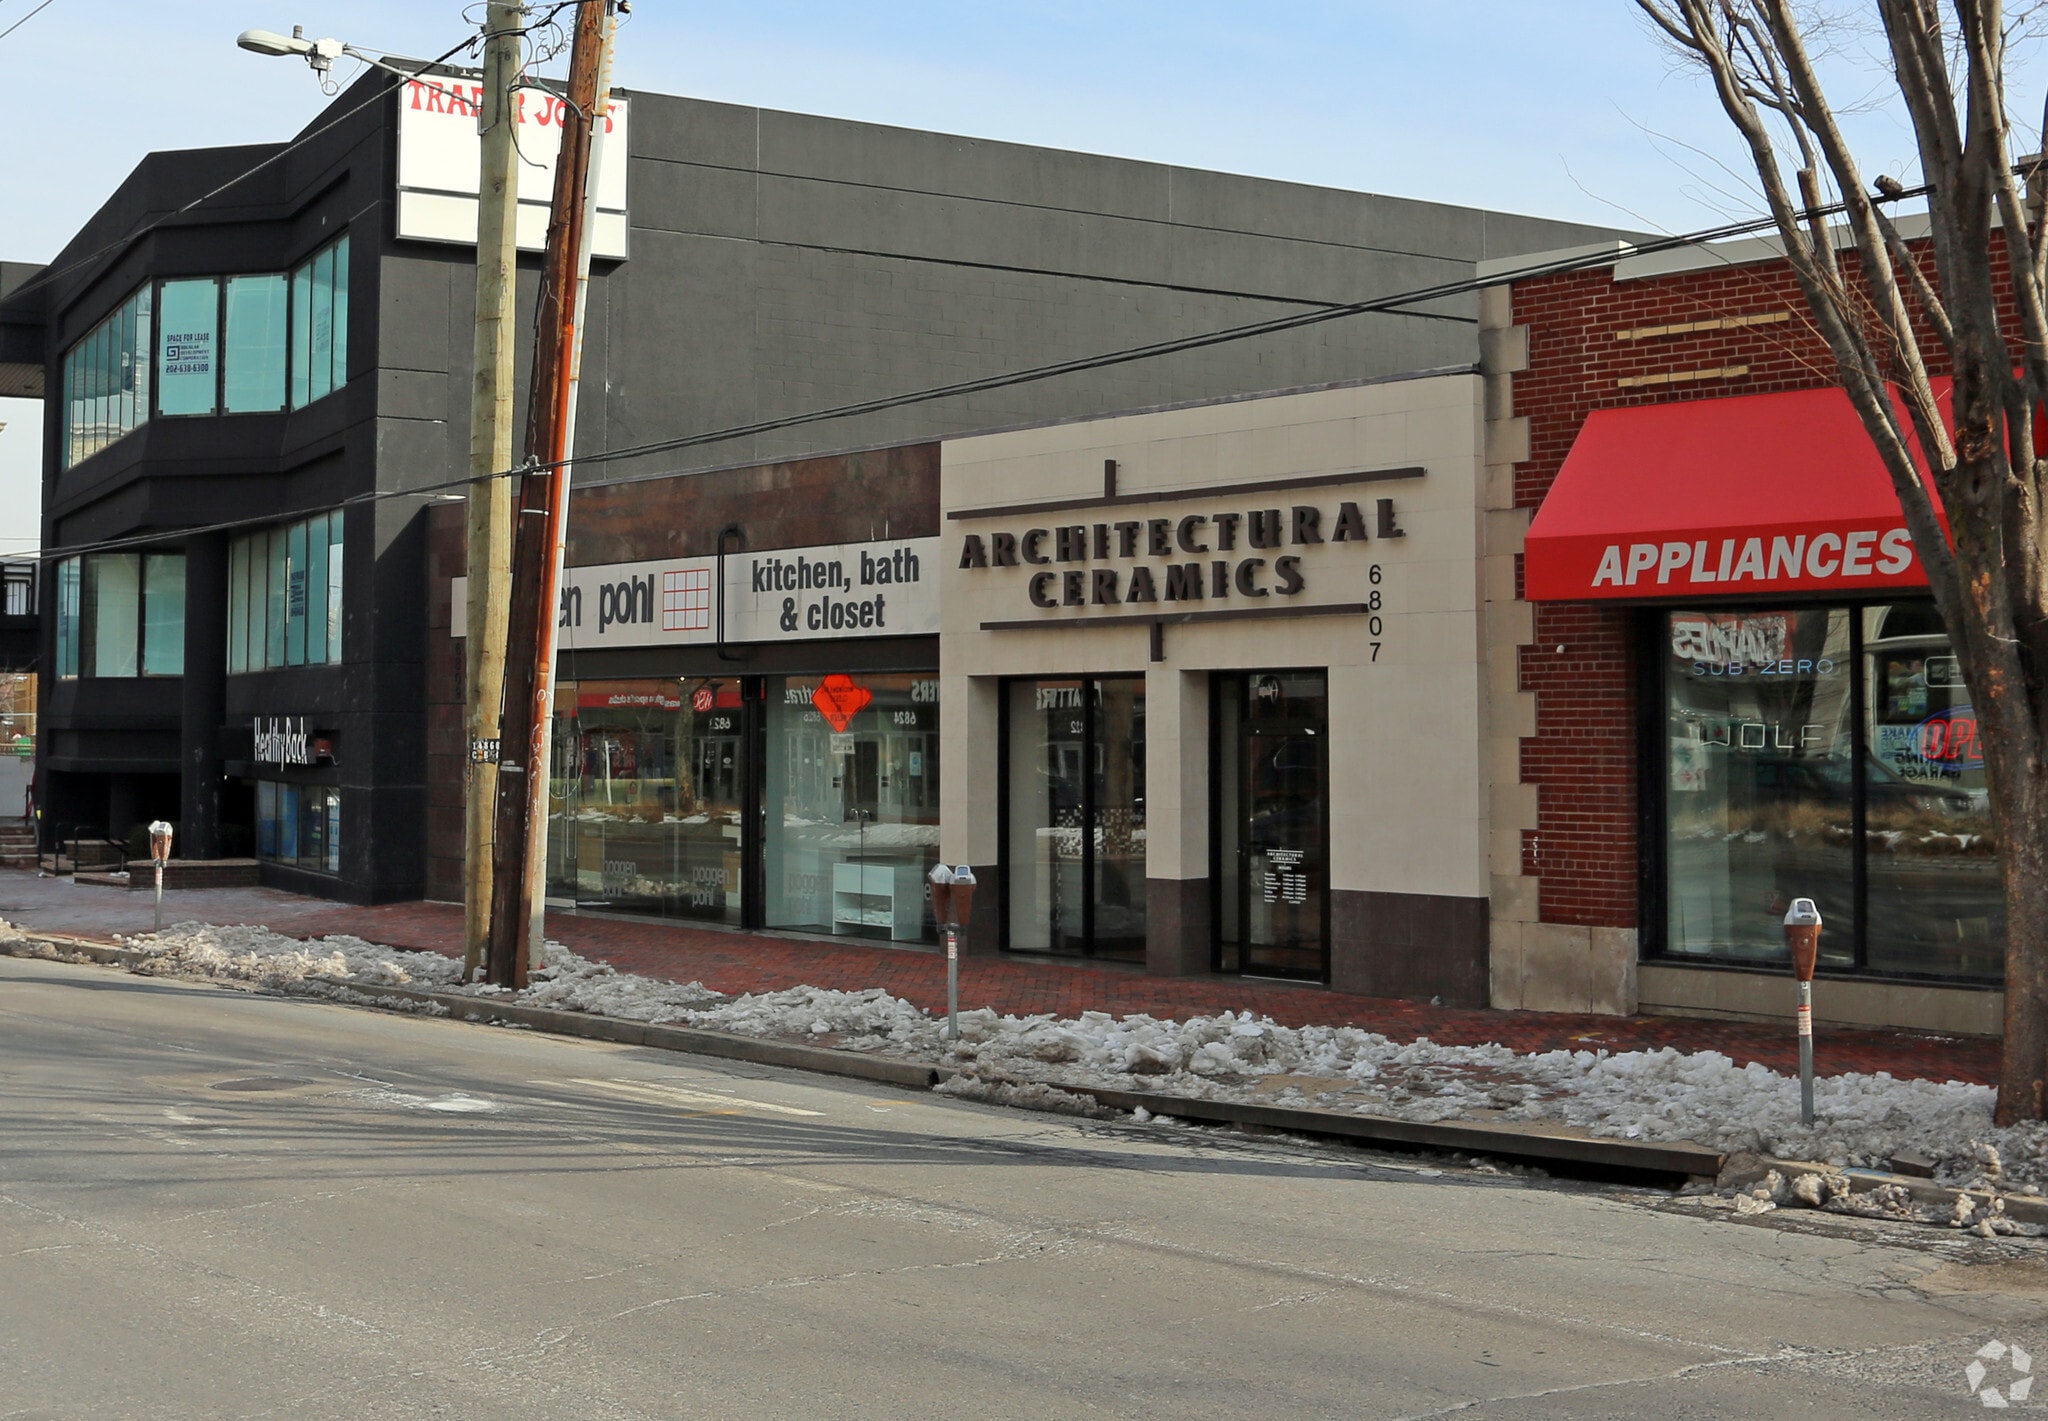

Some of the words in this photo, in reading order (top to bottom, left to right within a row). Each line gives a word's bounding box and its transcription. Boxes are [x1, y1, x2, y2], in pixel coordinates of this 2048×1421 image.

[407, 79, 526, 124] TRAD
[534, 96, 616, 133] JOS
[167, 334, 182, 342] SPACE
[183, 333, 193, 341] FOR
[194, 332, 209, 341] LEASE
[959, 498, 1406, 569] ARCHITECTURAL
[1591, 528, 1913, 587] APPLIANCES
[752, 556, 850, 593] kitchen,
[860, 547, 919, 585] bath
[1028, 555, 1305, 608] CERAMICS
[599, 573, 655, 634] pohl
[780, 597, 798, 632] &
[807, 594, 885, 631] closet
[1368, 564, 1382, 663] 6807
[254, 716, 285, 772] Healthy
[285, 716, 307, 764] Back
[692, 866, 730, 886] poggen
[692, 888, 714, 908] pohl
